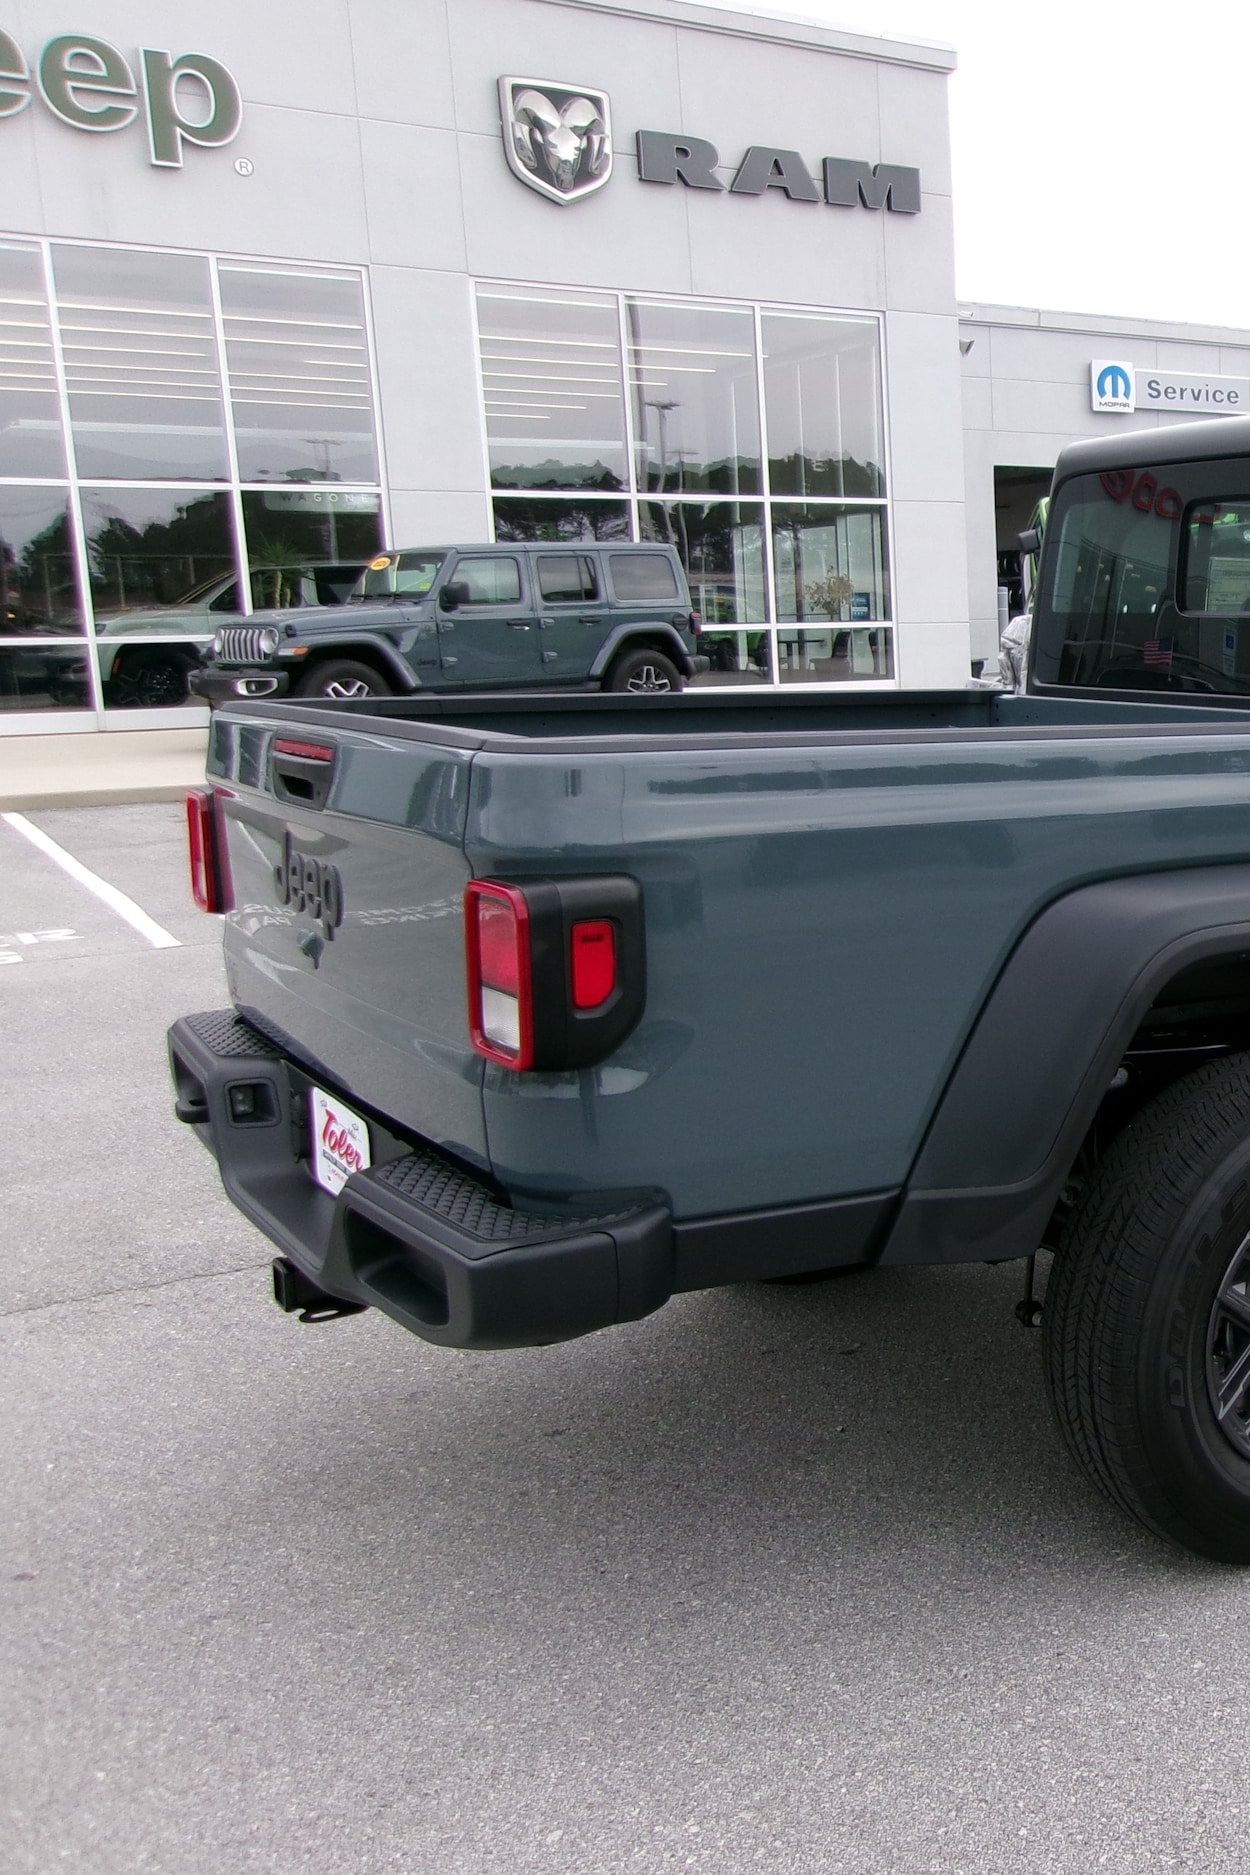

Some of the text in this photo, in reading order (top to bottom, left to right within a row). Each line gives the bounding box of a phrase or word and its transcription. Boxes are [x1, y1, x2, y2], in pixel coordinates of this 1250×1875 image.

[635, 129, 921, 214] RAM
[1147, 379, 1240, 405] Service
[273, 828, 345, 942] Jeep
[322, 1108, 364, 1173] Toler
